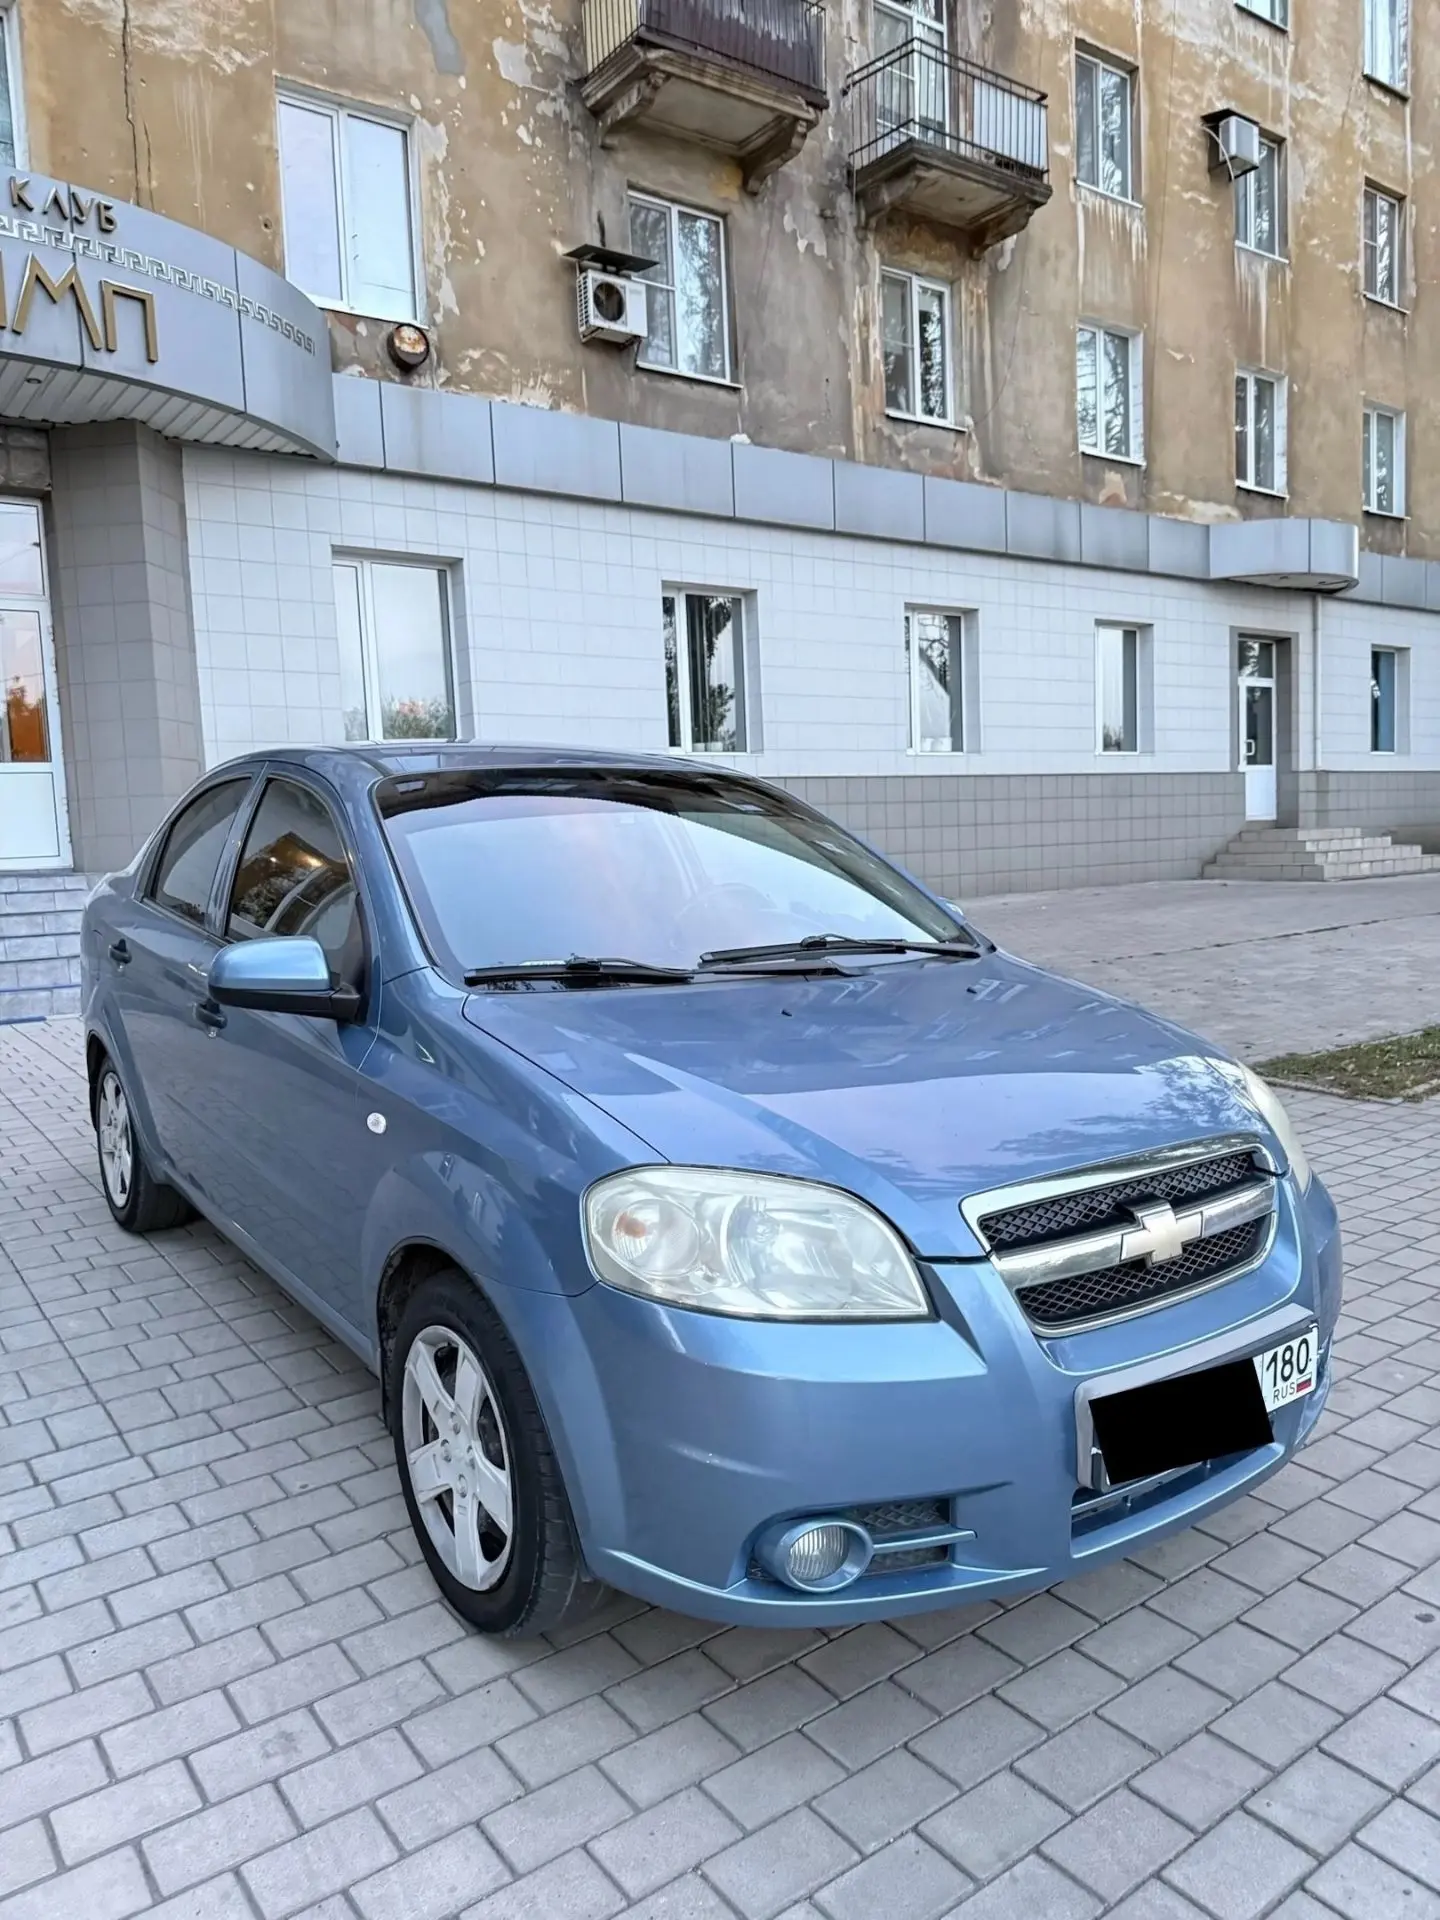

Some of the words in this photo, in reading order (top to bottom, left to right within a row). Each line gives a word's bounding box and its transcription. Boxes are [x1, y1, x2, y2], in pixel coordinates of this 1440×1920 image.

[9, 175, 117, 232] КЛУБ
[0, 251, 158, 362] МП
[1266, 1338, 1310, 1388] 180
[1273, 1382, 1296, 1403] RUS
